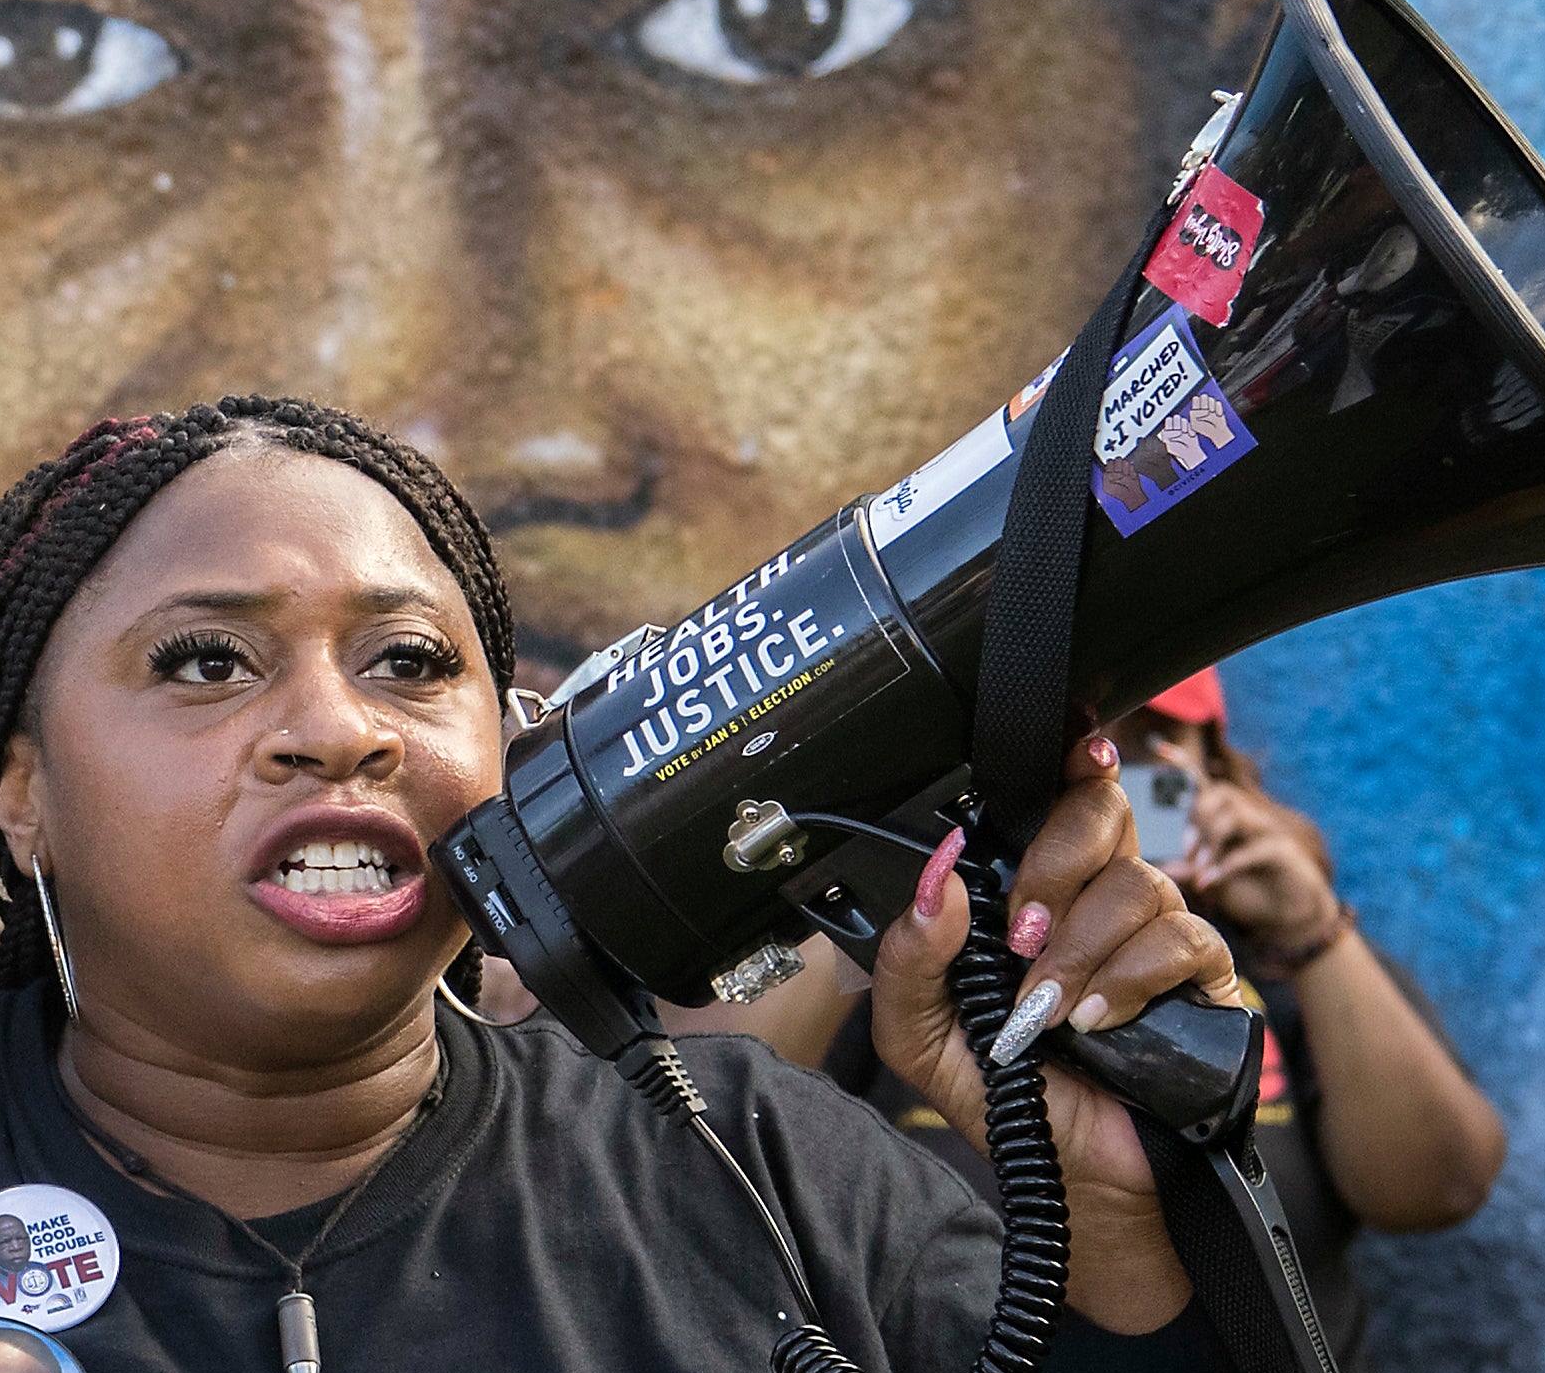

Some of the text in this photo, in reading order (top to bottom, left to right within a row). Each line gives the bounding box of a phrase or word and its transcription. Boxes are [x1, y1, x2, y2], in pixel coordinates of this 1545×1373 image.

[1104, 341, 1179, 423] MARCHED
[1113, 420, 1128, 446] I
[1130, 361, 1189, 427] VOTED!
[608, 551, 806, 694] HEALTH.
[643, 601, 785, 708] JOBS.
[623, 608, 846, 777] JUSTICE.
[656, 753, 691, 782] VOTE
[691, 747, 705, 761] BY
[704, 727, 729, 753] JAN
[729, 720, 740, 734] 5
[453, 845, 478, 883] OFF ON
[484, 899, 507, 935] VOLUME
[27, 1214, 71, 1235] MAKE
[31, 1226, 76, 1246] GOOD
[34, 1231, 106, 1258] TROUBLE
